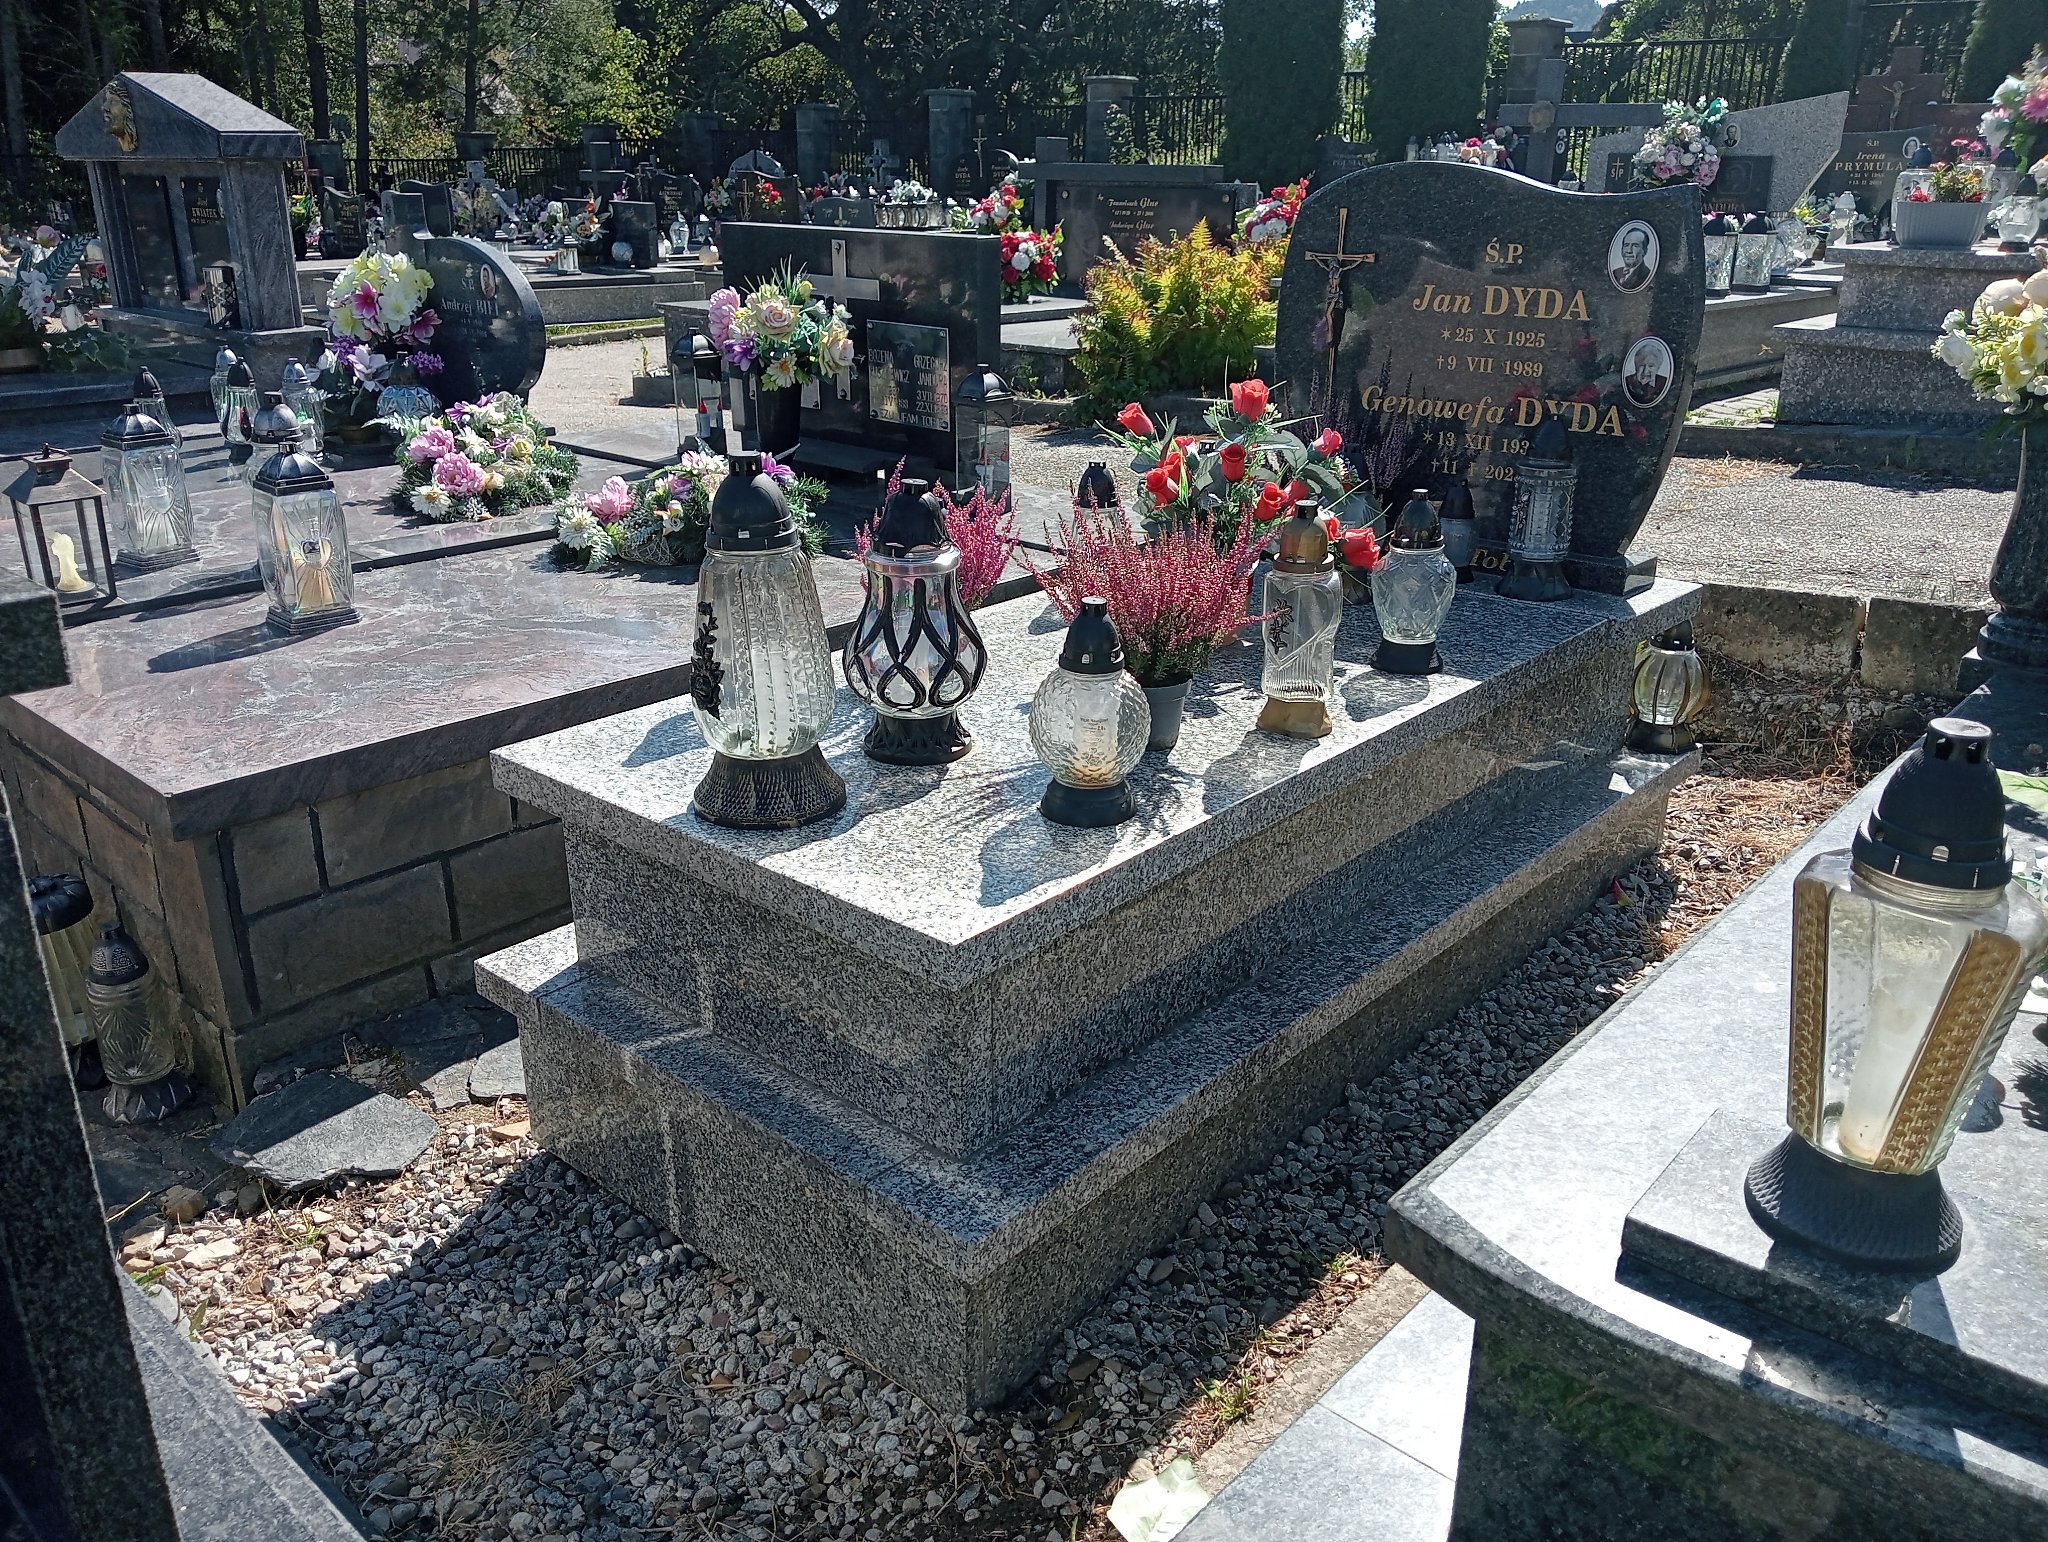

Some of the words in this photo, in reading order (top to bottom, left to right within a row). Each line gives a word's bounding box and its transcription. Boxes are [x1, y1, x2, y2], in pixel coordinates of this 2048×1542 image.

[1834, 162, 1903, 171] PRYMULA
[1856, 152, 1886, 160] Irena
[1485, 236, 1523, 264] Ś.P.
[441, 297, 473, 316] Andrzej
[1412, 284, 1472, 315] Jan
[1481, 285, 1591, 321] DYDA
[1483, 328, 1499, 345] X
[1505, 330, 1546, 348] 1925
[1466, 356, 1494, 374] VII
[1503, 360, 1543, 378] 1989
[1361, 385, 1506, 428] Genowefa
[1514, 396, 1625, 437] DYDA
[1464, 433, 1492, 452] XII
[1500, 438, 1531, 456] 193
[1484, 464, 1515, 482] 202
